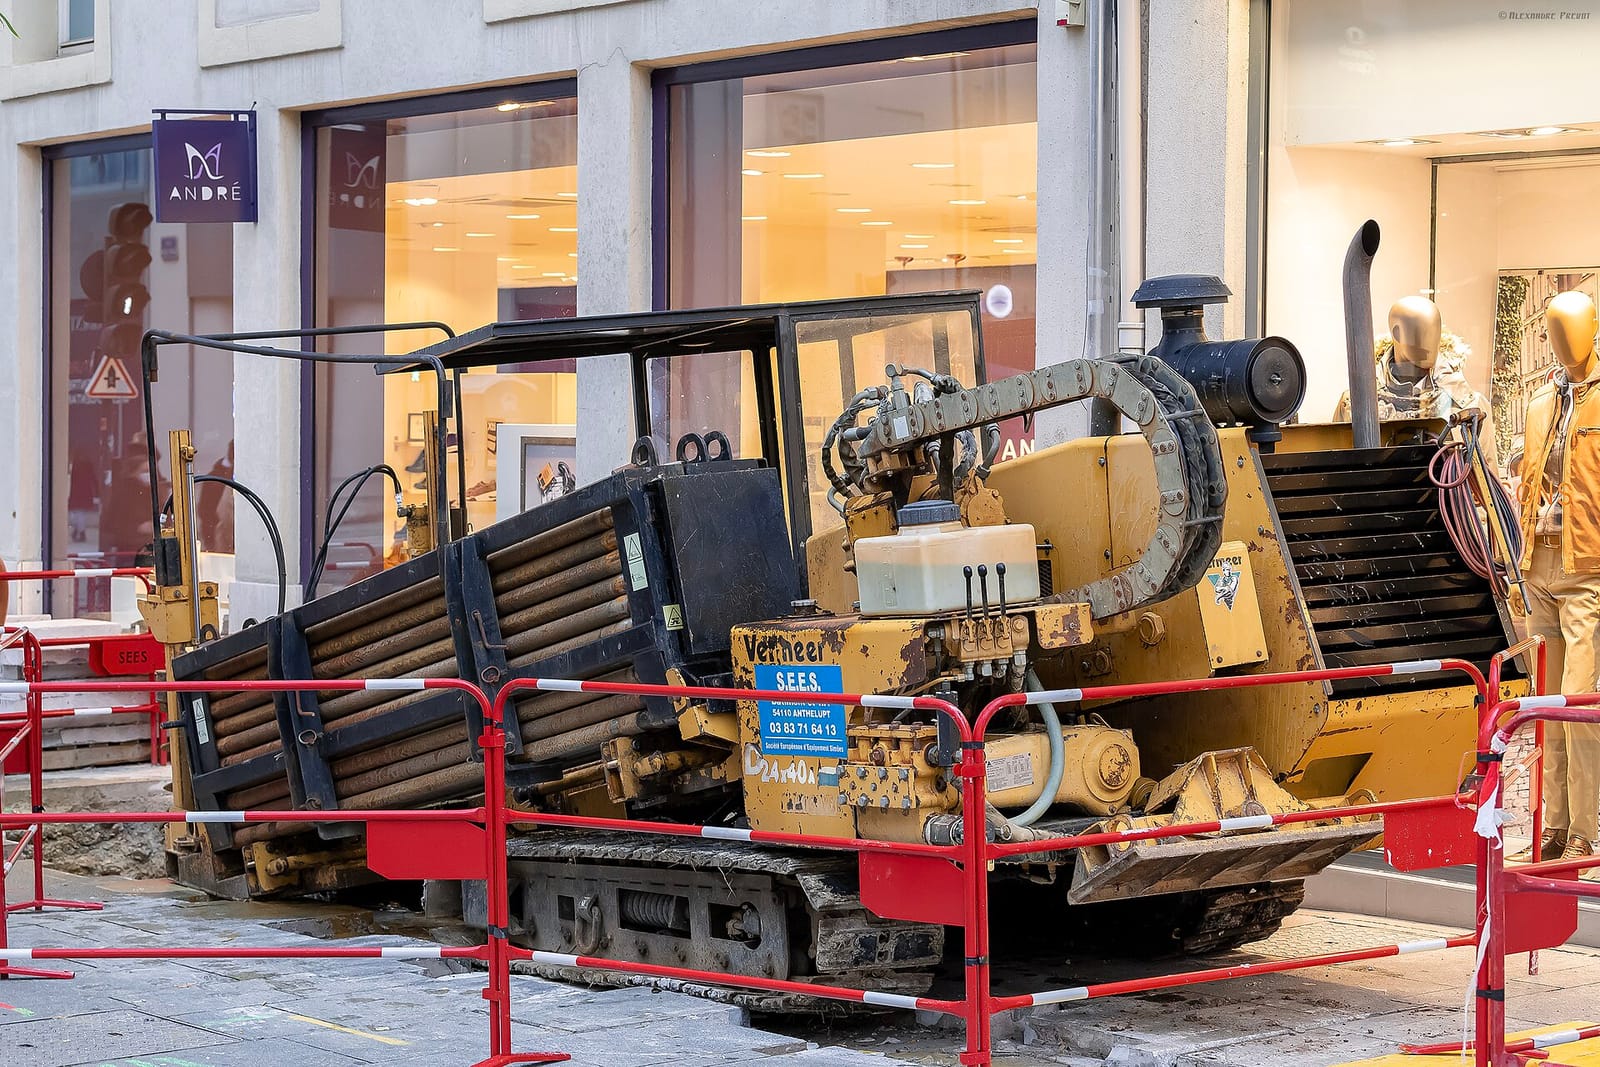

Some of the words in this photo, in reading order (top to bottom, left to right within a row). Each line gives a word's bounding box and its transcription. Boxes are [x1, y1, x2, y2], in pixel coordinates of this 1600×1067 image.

[169, 181, 241, 201] ANDRÉ
[1001, 438, 1035, 461] AN
[119, 651, 148, 664] SEES
[776, 671, 821, 691] S.E.E.S.
[772, 708, 791, 717] 54110
[792, 709, 830, 718] ANTHELUPT
[769, 722, 782, 733] 03
[783, 722, 796, 734] 83
[797, 723, 808, 734] 71
[811, 723, 823, 735] 64
[825, 724, 837, 736] 13
